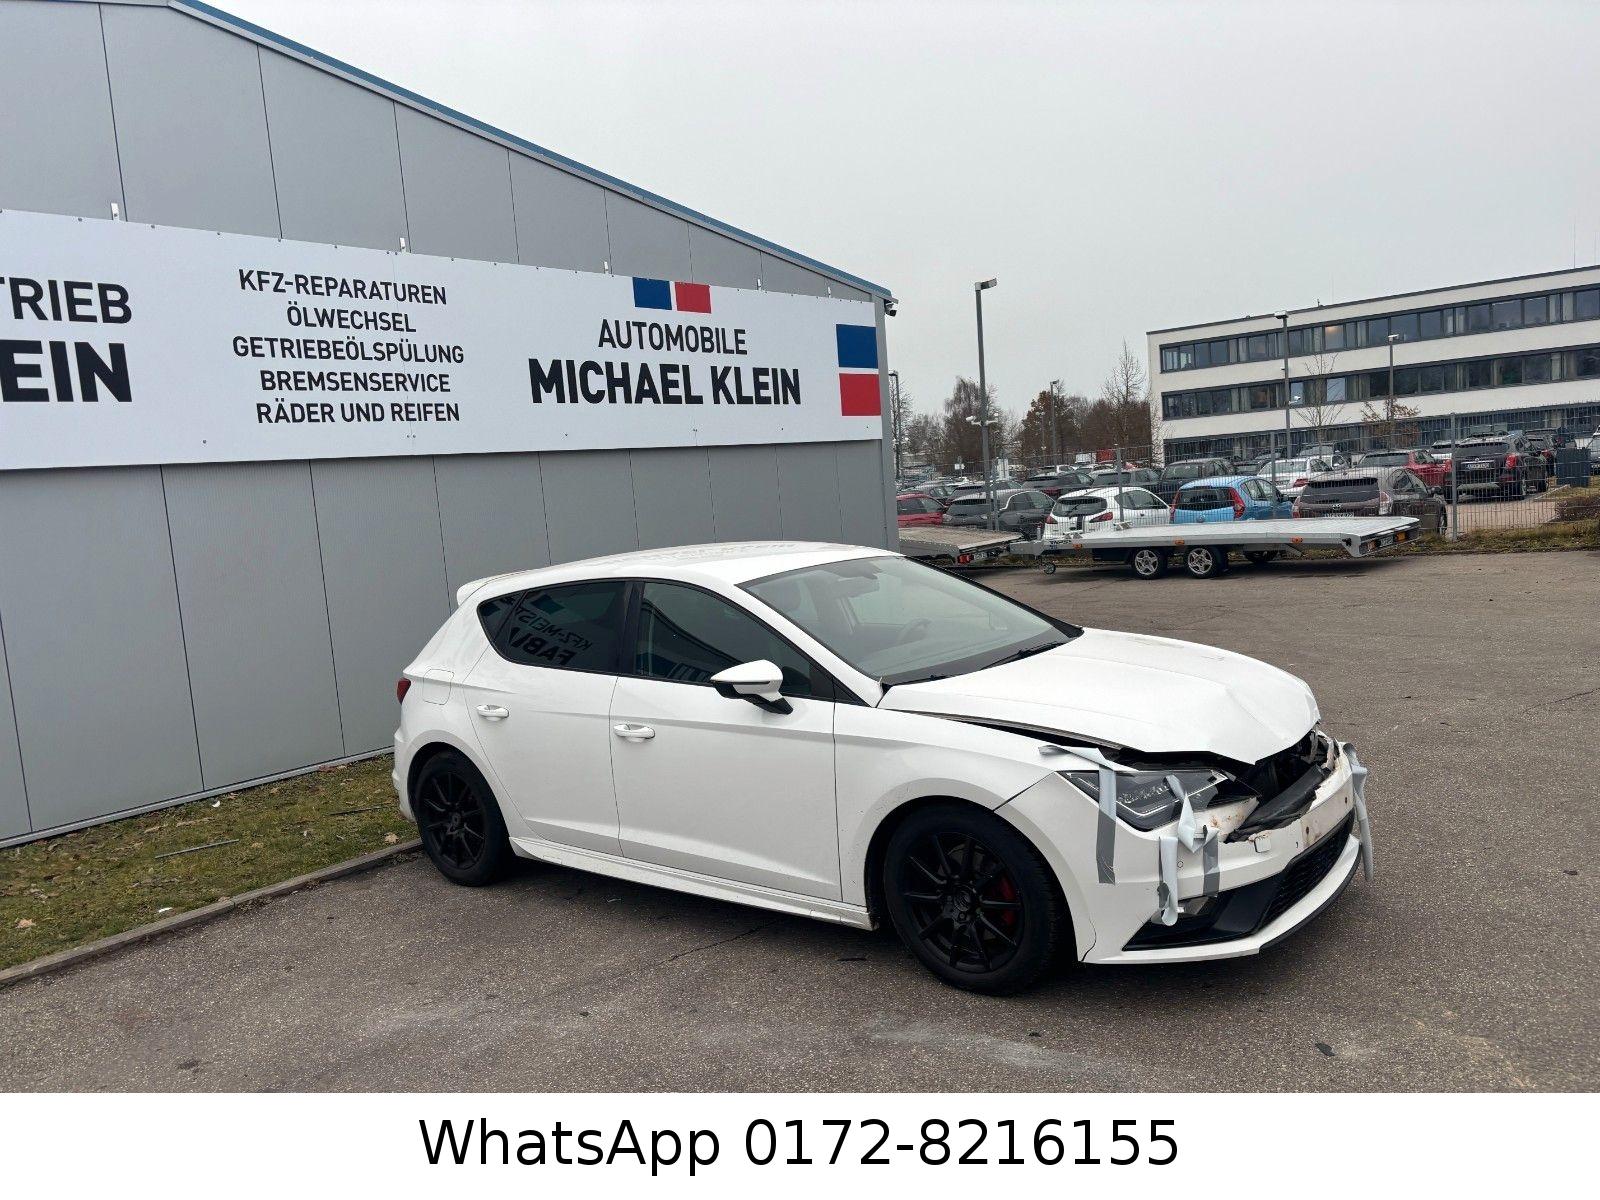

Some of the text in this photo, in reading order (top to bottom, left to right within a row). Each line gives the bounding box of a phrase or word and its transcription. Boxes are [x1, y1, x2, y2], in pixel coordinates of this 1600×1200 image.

[0, 276, 132, 324] RIEB
[238, 268, 447, 305] KFZ-REPARATUREN
[287, 301, 417, 333] ÖLWECHSEL
[232, 331, 465, 364] GETRIEBEÖLSPÜLUNG
[598, 318, 748, 356] AUTOMOBILE
[260, 369, 451, 393] BREMSENSERVICE
[528, 358, 802, 405] MICHAEL KLEIN
[256, 398, 460, 424] RÄDER UND REIFEN
